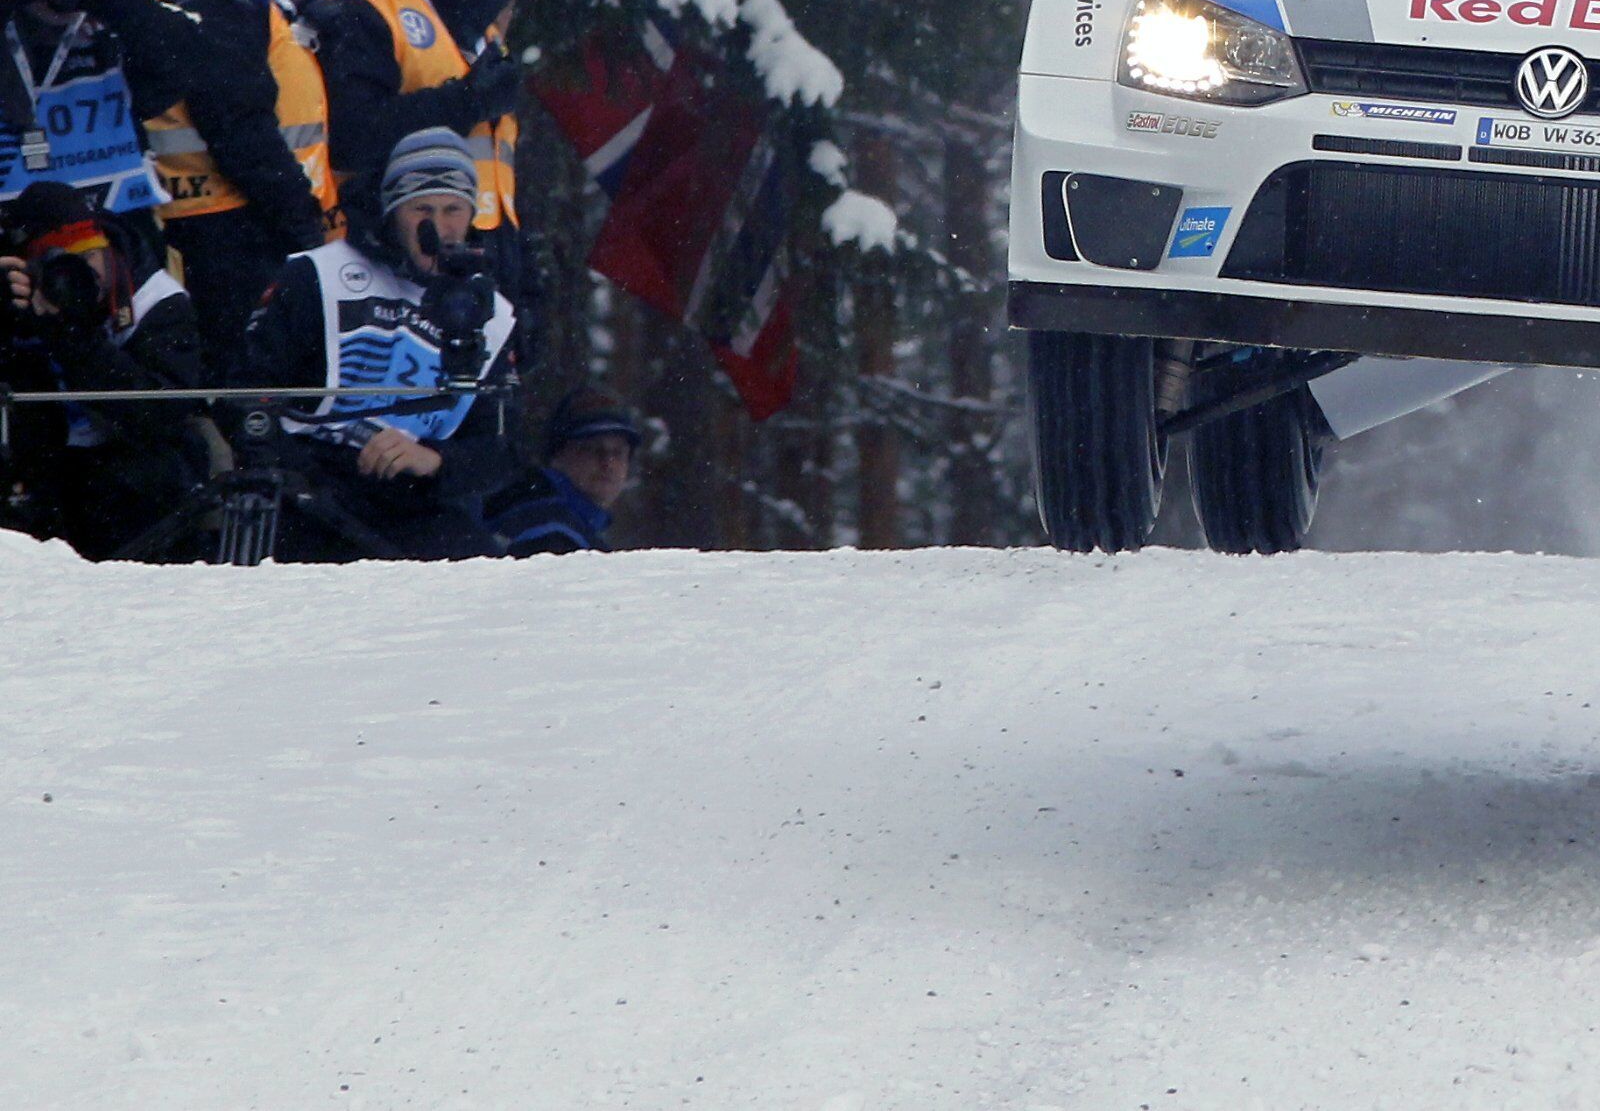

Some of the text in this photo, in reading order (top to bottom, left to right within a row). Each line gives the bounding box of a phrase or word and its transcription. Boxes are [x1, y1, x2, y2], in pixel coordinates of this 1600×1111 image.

[1367, 106, 1455, 120] MICHELIN
[1133, 113, 1223, 139] Castrol EDGE
[1494, 123, 1531, 140] WOB
[1543, 127, 1568, 143] VW
[1179, 216, 1216, 232] ultimate
